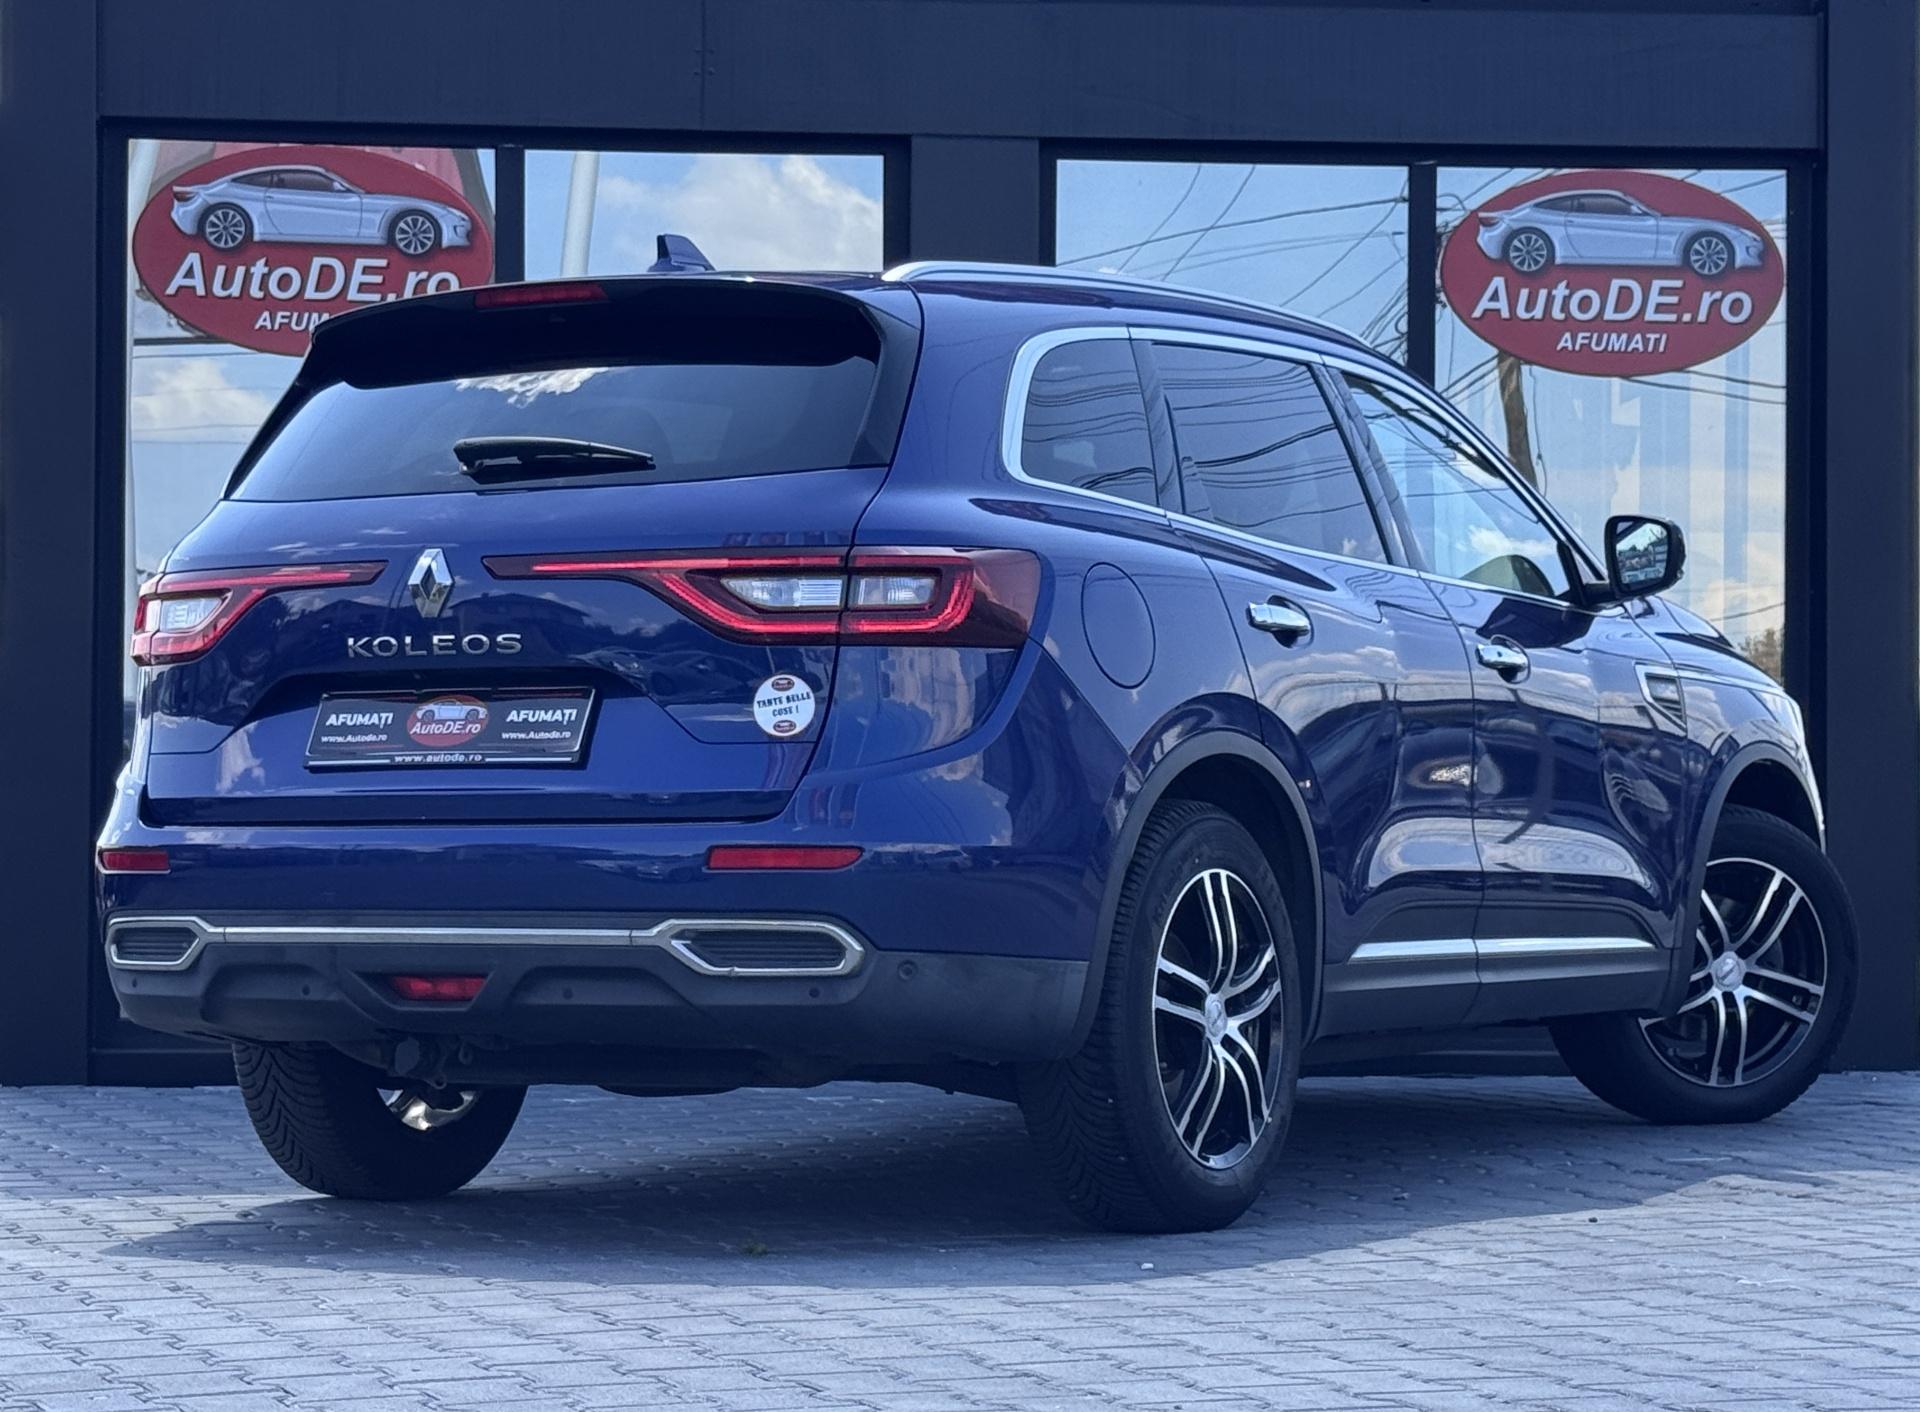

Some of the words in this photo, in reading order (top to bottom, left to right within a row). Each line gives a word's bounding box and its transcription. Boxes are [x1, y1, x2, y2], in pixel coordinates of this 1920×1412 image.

[165, 252, 460, 301] AutoDE.ro
[1472, 276, 1753, 325] AutoDE.ro
[254, 311, 330, 331] AFUM
[1556, 332, 1668, 353] AFUMATI
[347, 633, 523, 658] KOLEOS
[756, 696, 783, 708] TANTE
[772, 706, 793, 717] COSE
[409, 720, 482, 736] AutoDE.ro
[393, 752, 483, 763] www.autode.ro
